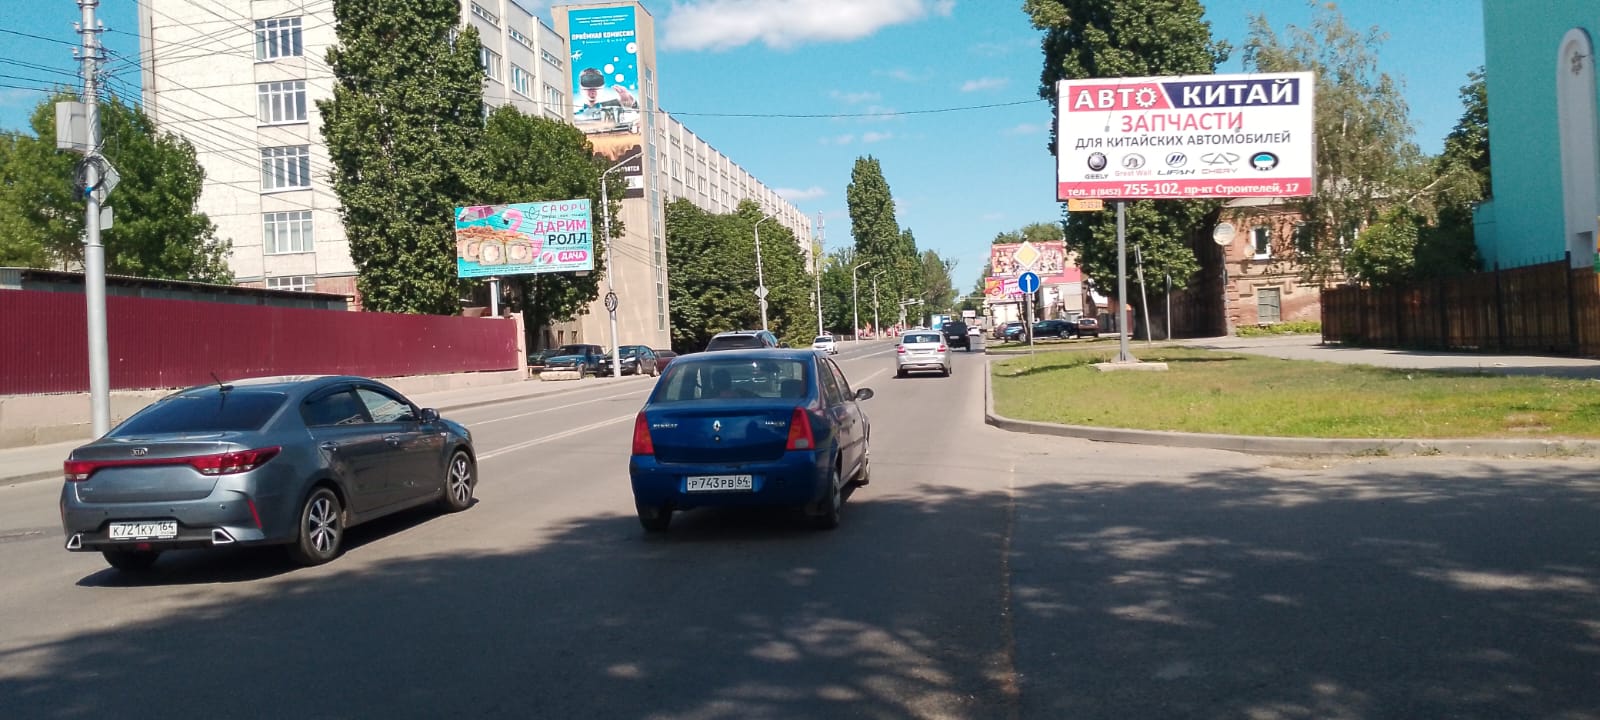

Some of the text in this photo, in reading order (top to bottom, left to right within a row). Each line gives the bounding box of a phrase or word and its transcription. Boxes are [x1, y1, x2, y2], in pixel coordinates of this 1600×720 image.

[1183, 79, 1293, 106] КИТАЙ
[1121, 112, 1243, 132] ЗАПЧАСТИ
[1075, 130, 1291, 150] ДЛЯ КИТАЙСКИХ АВТОМОБИЛЕЙ
[1068, 188, 1088, 196] тел.
[1123, 183, 1181, 196] 755-102,
[1184, 186, 1213, 195] пр-кт
[1215, 183, 1283, 194] Строителей,
[1286, 183, 1299, 192] 17
[534, 219, 587, 235] ДАРИМ
[548, 232, 587, 245] РОЛЛ
[561, 251, 584, 260] ДАЧА
